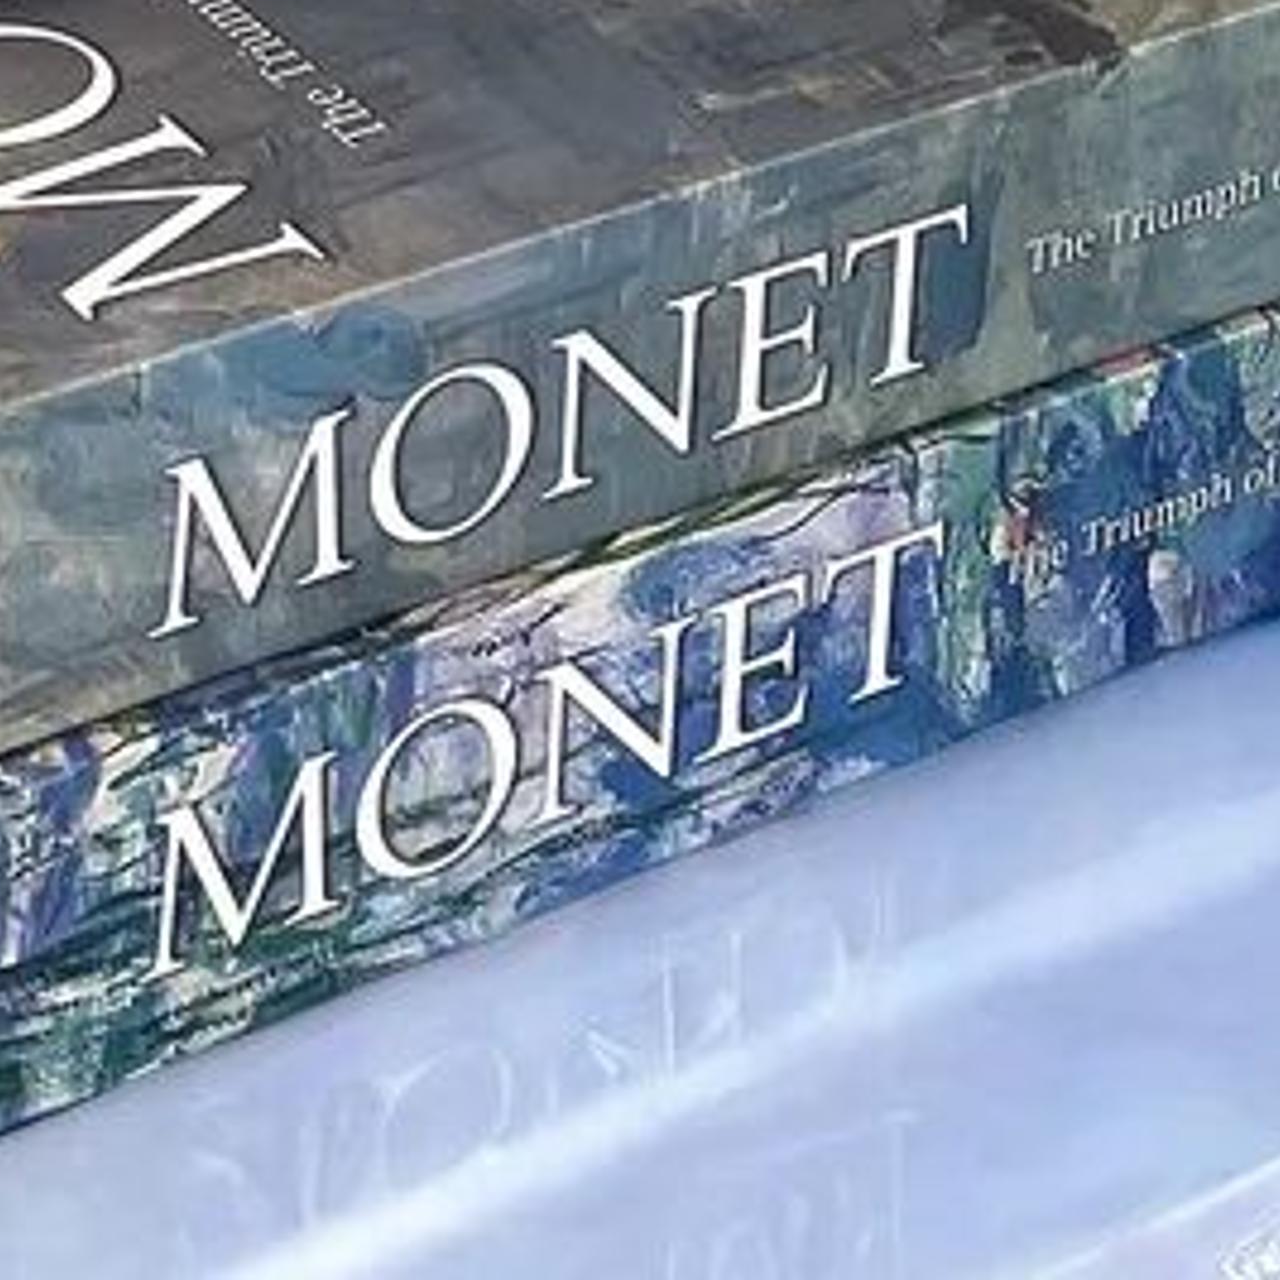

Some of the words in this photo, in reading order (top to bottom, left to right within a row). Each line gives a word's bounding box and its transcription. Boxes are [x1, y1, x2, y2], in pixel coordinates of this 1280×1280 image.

[306, 85, 384, 148] The
[1023, 222, 1098, 276] The
[1107, 168, 1262, 247] Triumph
[147, 204, 972, 640] MONET
[1080, 472, 1235, 560] Triumph
[143, 524, 947, 985] MONET
